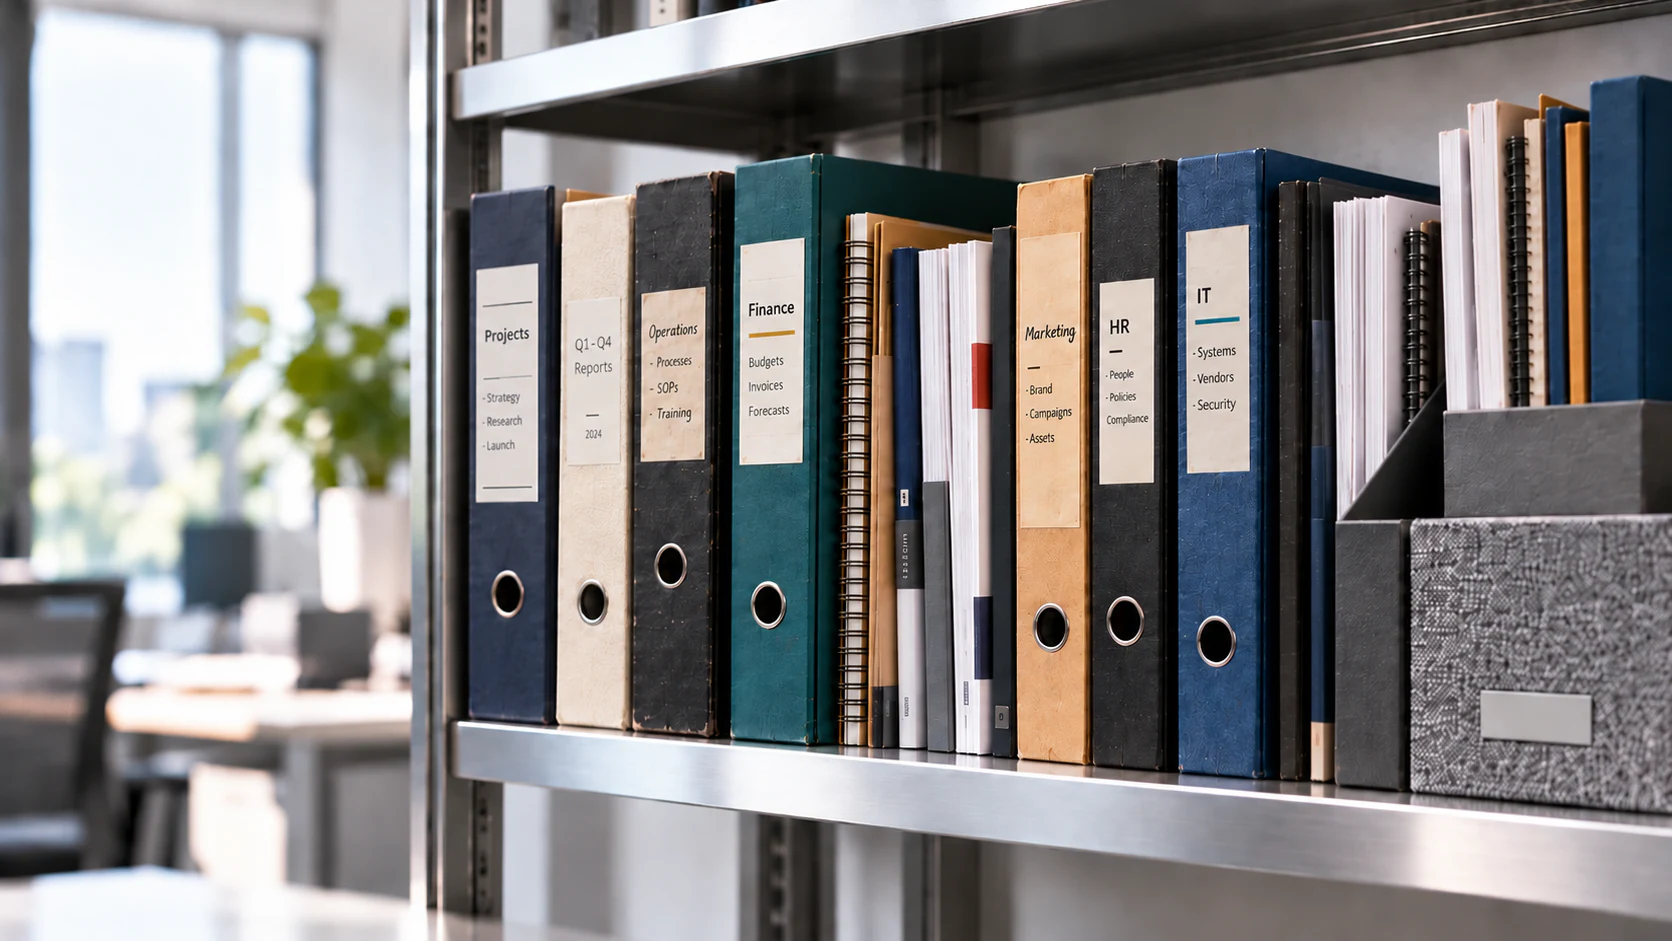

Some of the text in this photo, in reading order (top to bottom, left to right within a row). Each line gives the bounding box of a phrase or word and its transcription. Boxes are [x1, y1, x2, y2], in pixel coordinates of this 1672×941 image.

[1197, 287, 1212, 304] IT
[748, 302, 795, 317] Finance
[649, 323, 698, 344] Operations
[1025, 324, 1076, 343] Marketing
[1110, 319, 1130, 335] HR
[484, 328, 530, 345] Projects
[1197, 346, 1237, 361] Systems
[656, 356, 692, 368] Processes
[748, 356, 784, 370] Budgets
[574, 361, 613, 378] Reports
[1109, 369, 1134, 381] People
[1197, 371, 1235, 384] Vendors
[657, 381, 679, 394] SOPs
[748, 380, 784, 392] Invoices
[1029, 383, 1053, 395] Brand
[486, 392, 521, 404] Strategy
[1109, 391, 1137, 402] Policies
[748, 405, 790, 417] Forecasts
[1197, 398, 1237, 412] Security
[657, 407, 692, 422] Training
[1029, 407, 1073, 421] Campaigns
[1106, 414, 1149, 426] Compliance
[486, 415, 523, 427] Research
[585, 429, 602, 439] 2024
[1029, 433, 1055, 444] Assets
[486, 439, 516, 451] Launch
